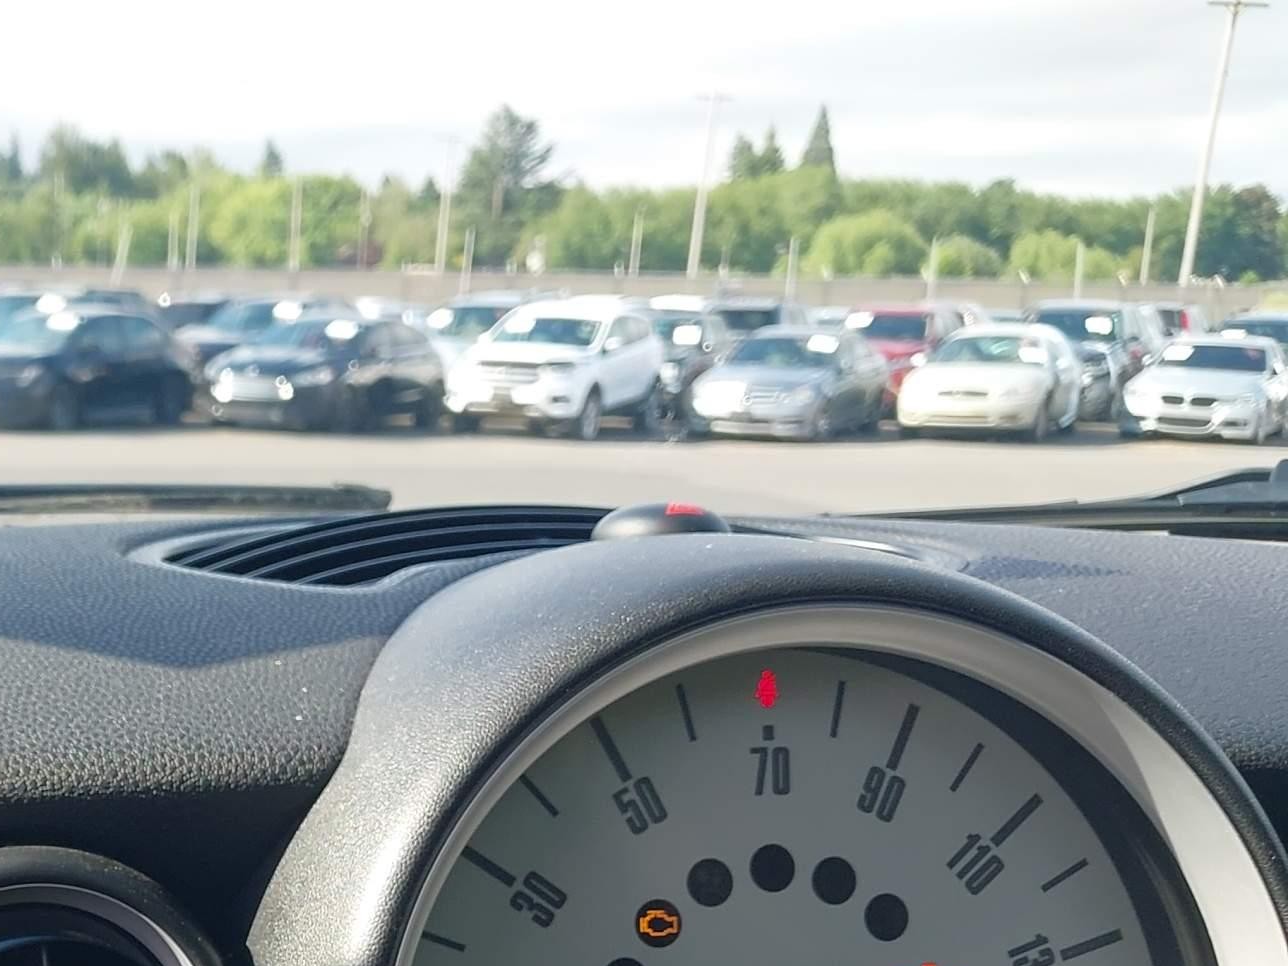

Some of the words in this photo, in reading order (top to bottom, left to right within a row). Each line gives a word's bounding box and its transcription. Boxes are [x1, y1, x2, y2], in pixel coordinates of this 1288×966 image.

[749, 746, 791, 796] 70
[857, 766, 907, 823] 90
[612, 776, 668, 836] 50
[945, 833, 1006, 896] 110
[509, 871, 568, 928] 30
